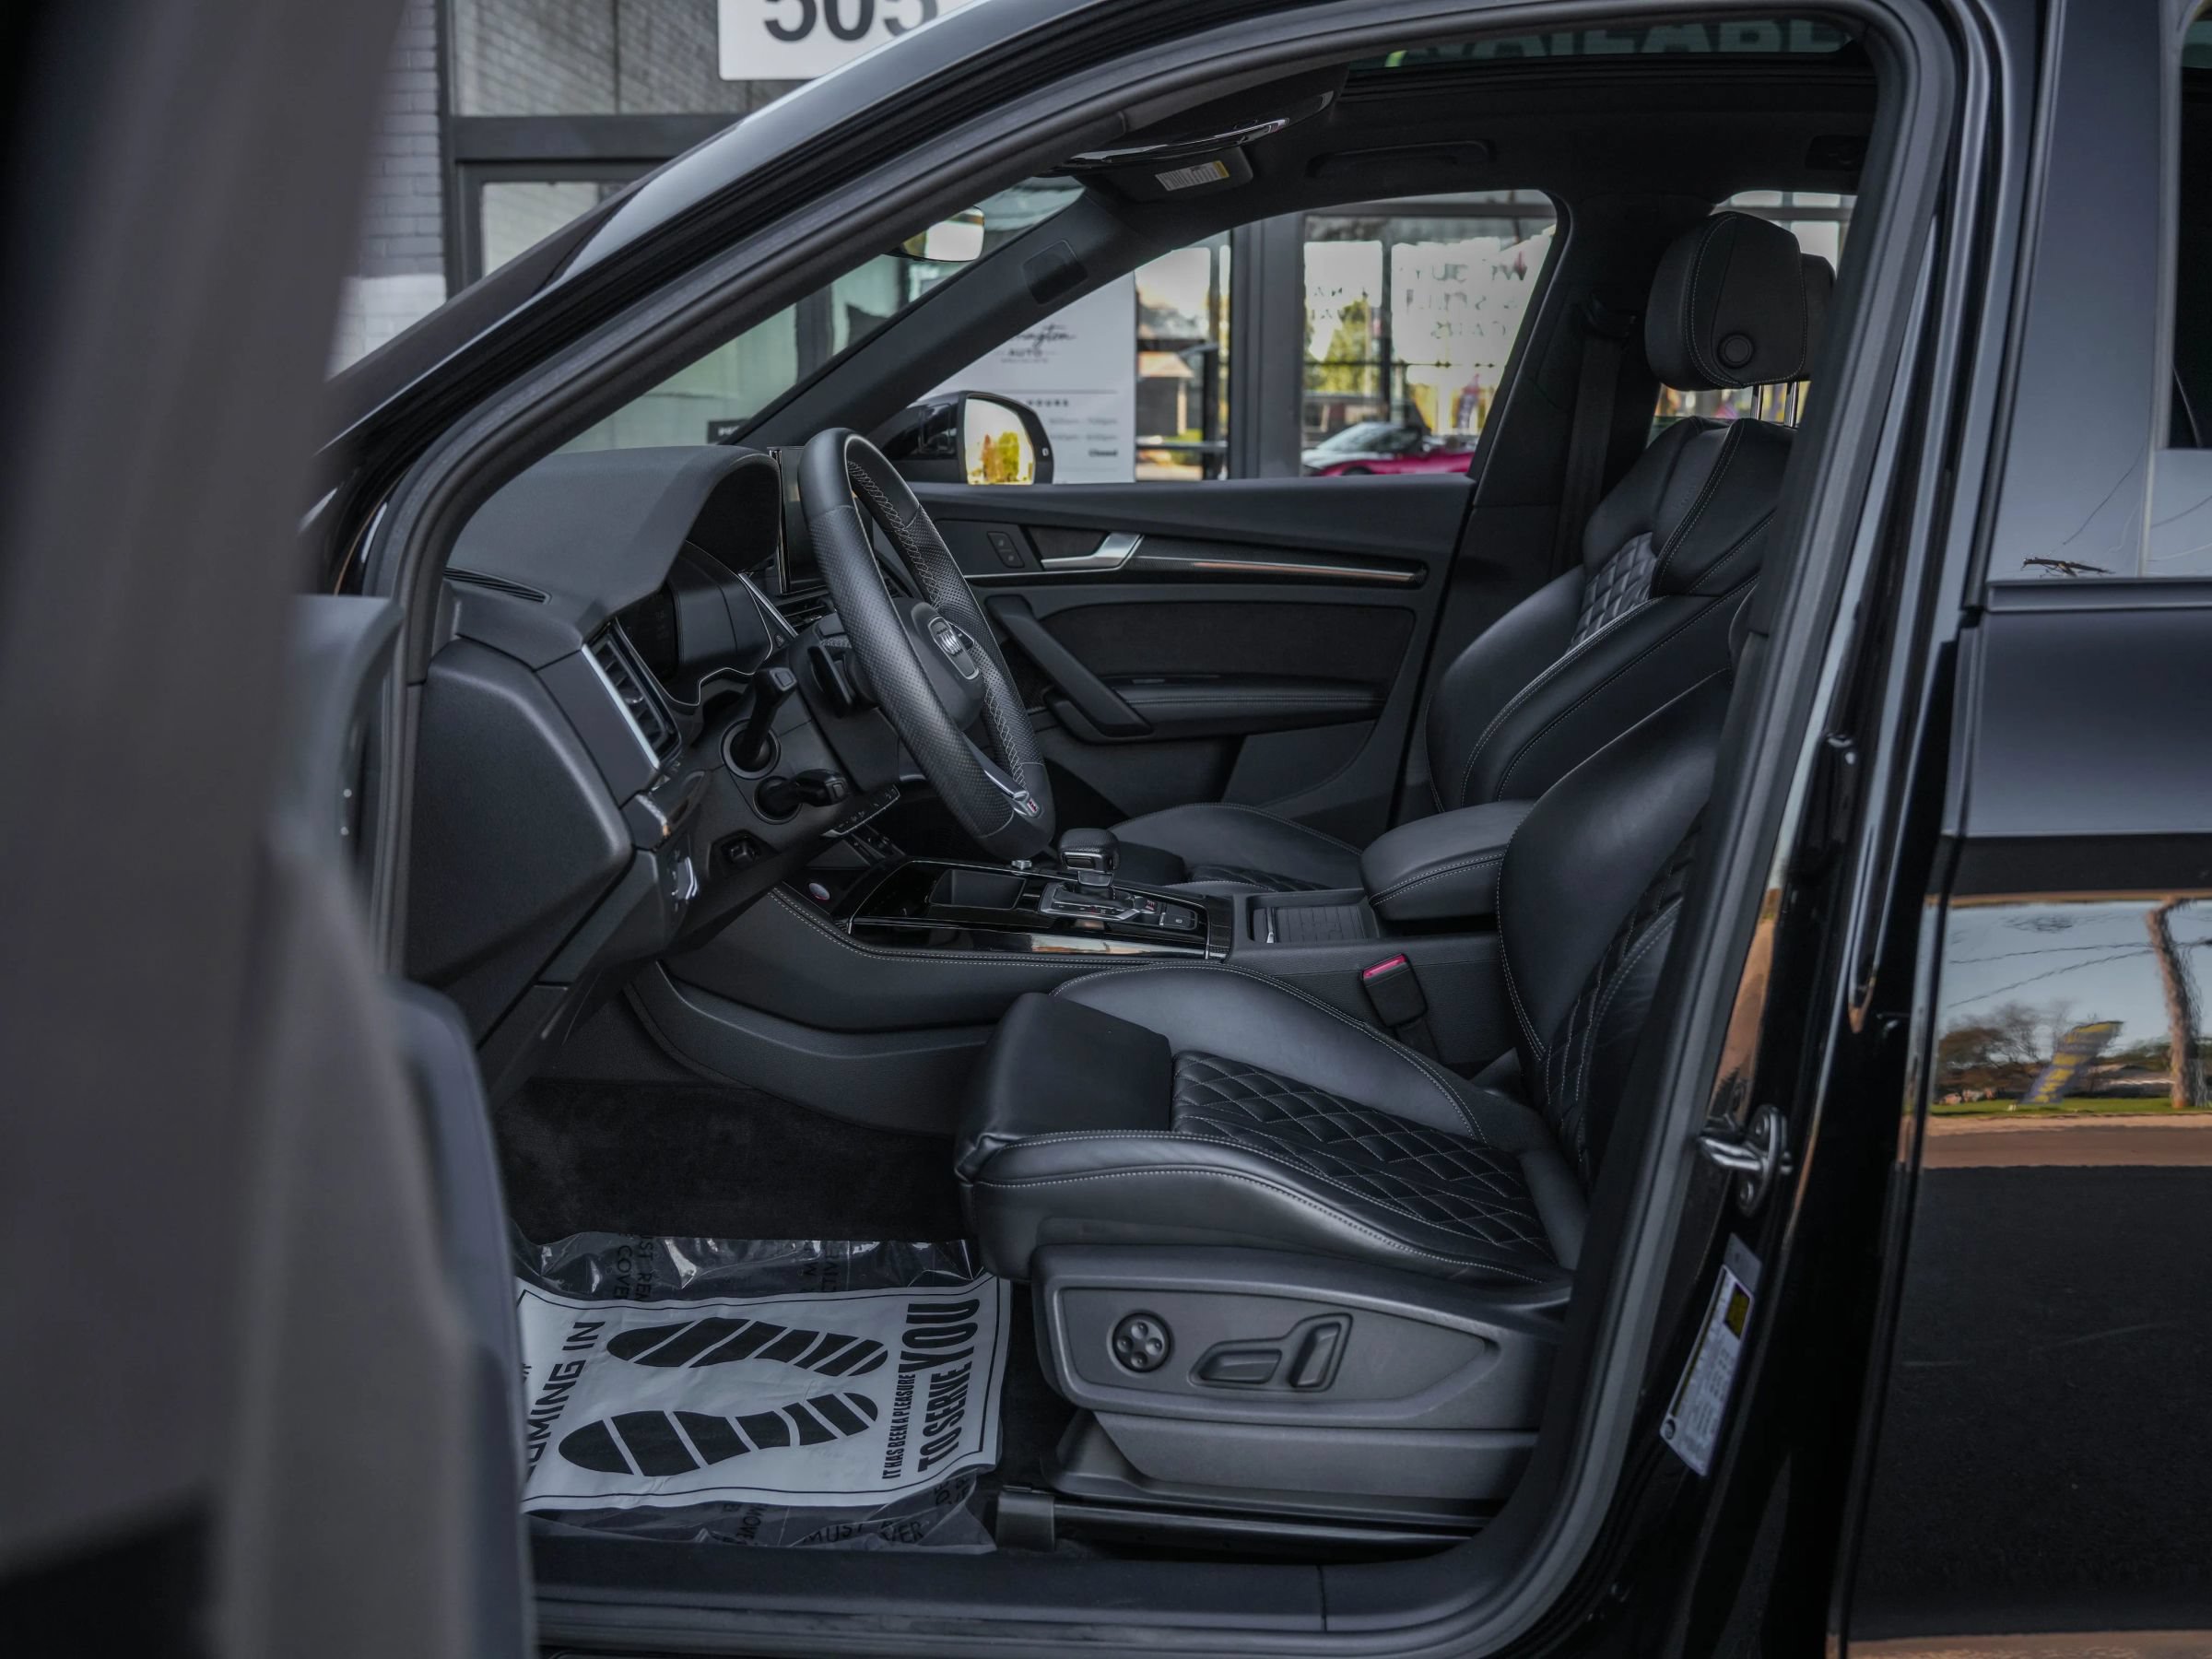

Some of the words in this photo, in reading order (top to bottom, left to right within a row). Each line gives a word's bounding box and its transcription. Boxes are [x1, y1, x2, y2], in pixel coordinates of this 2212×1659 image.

[561, 1321, 606, 1351] IN
[899, 1299, 981, 1373] YOU
[892, 1373, 916, 1417] PLEASURE
[923, 1361, 972, 1437] SERVE
[888, 1424, 908, 1448] BEEN
[918, 1427, 961, 1472] TO
[882, 1468, 901, 1479] IT
[884, 1448, 904, 1467] HAS
